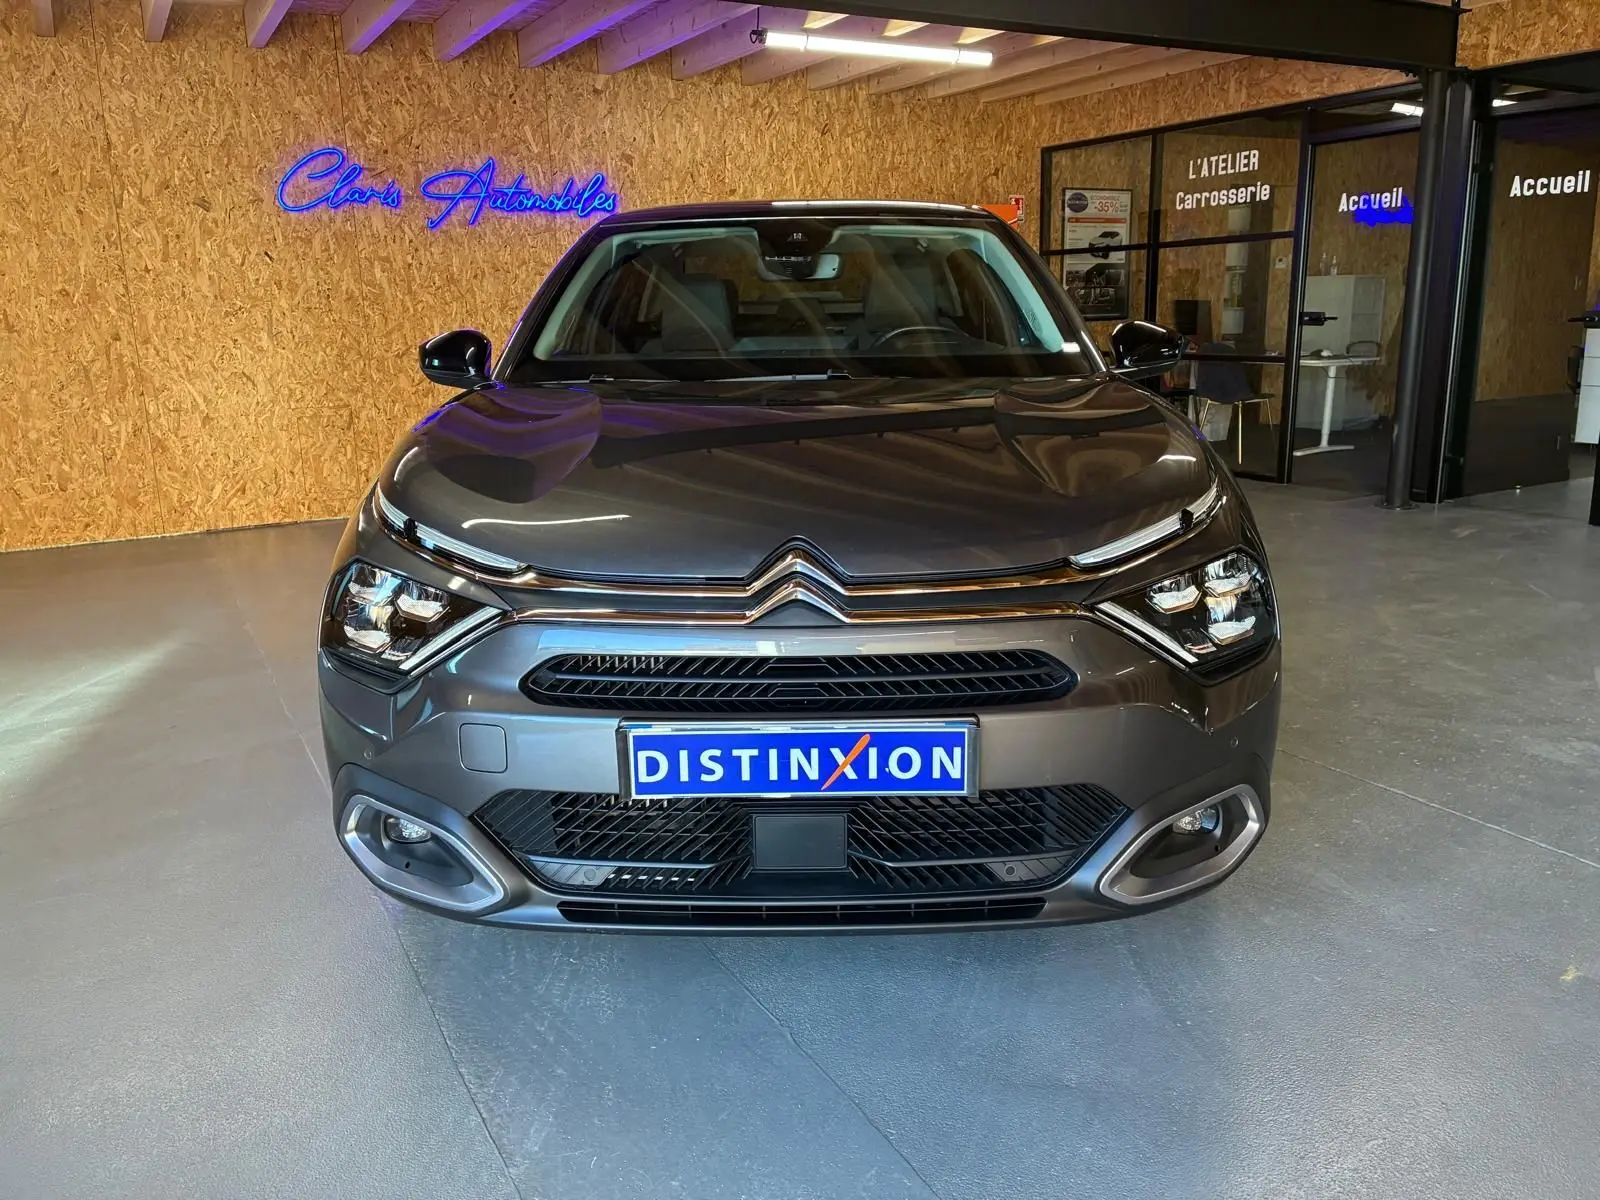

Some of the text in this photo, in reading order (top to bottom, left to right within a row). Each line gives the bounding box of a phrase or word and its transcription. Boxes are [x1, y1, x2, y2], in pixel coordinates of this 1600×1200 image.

[1189, 149, 1259, 179] L'ATELIER
[278, 148, 617, 229] Claris Automobiles
[1176, 181, 1270, 210] Carrosserie
[1509, 170, 1591, 197] Accueil
[1339, 187, 1403, 212] Accueil
[637, 733, 962, 791] DISTINXION
